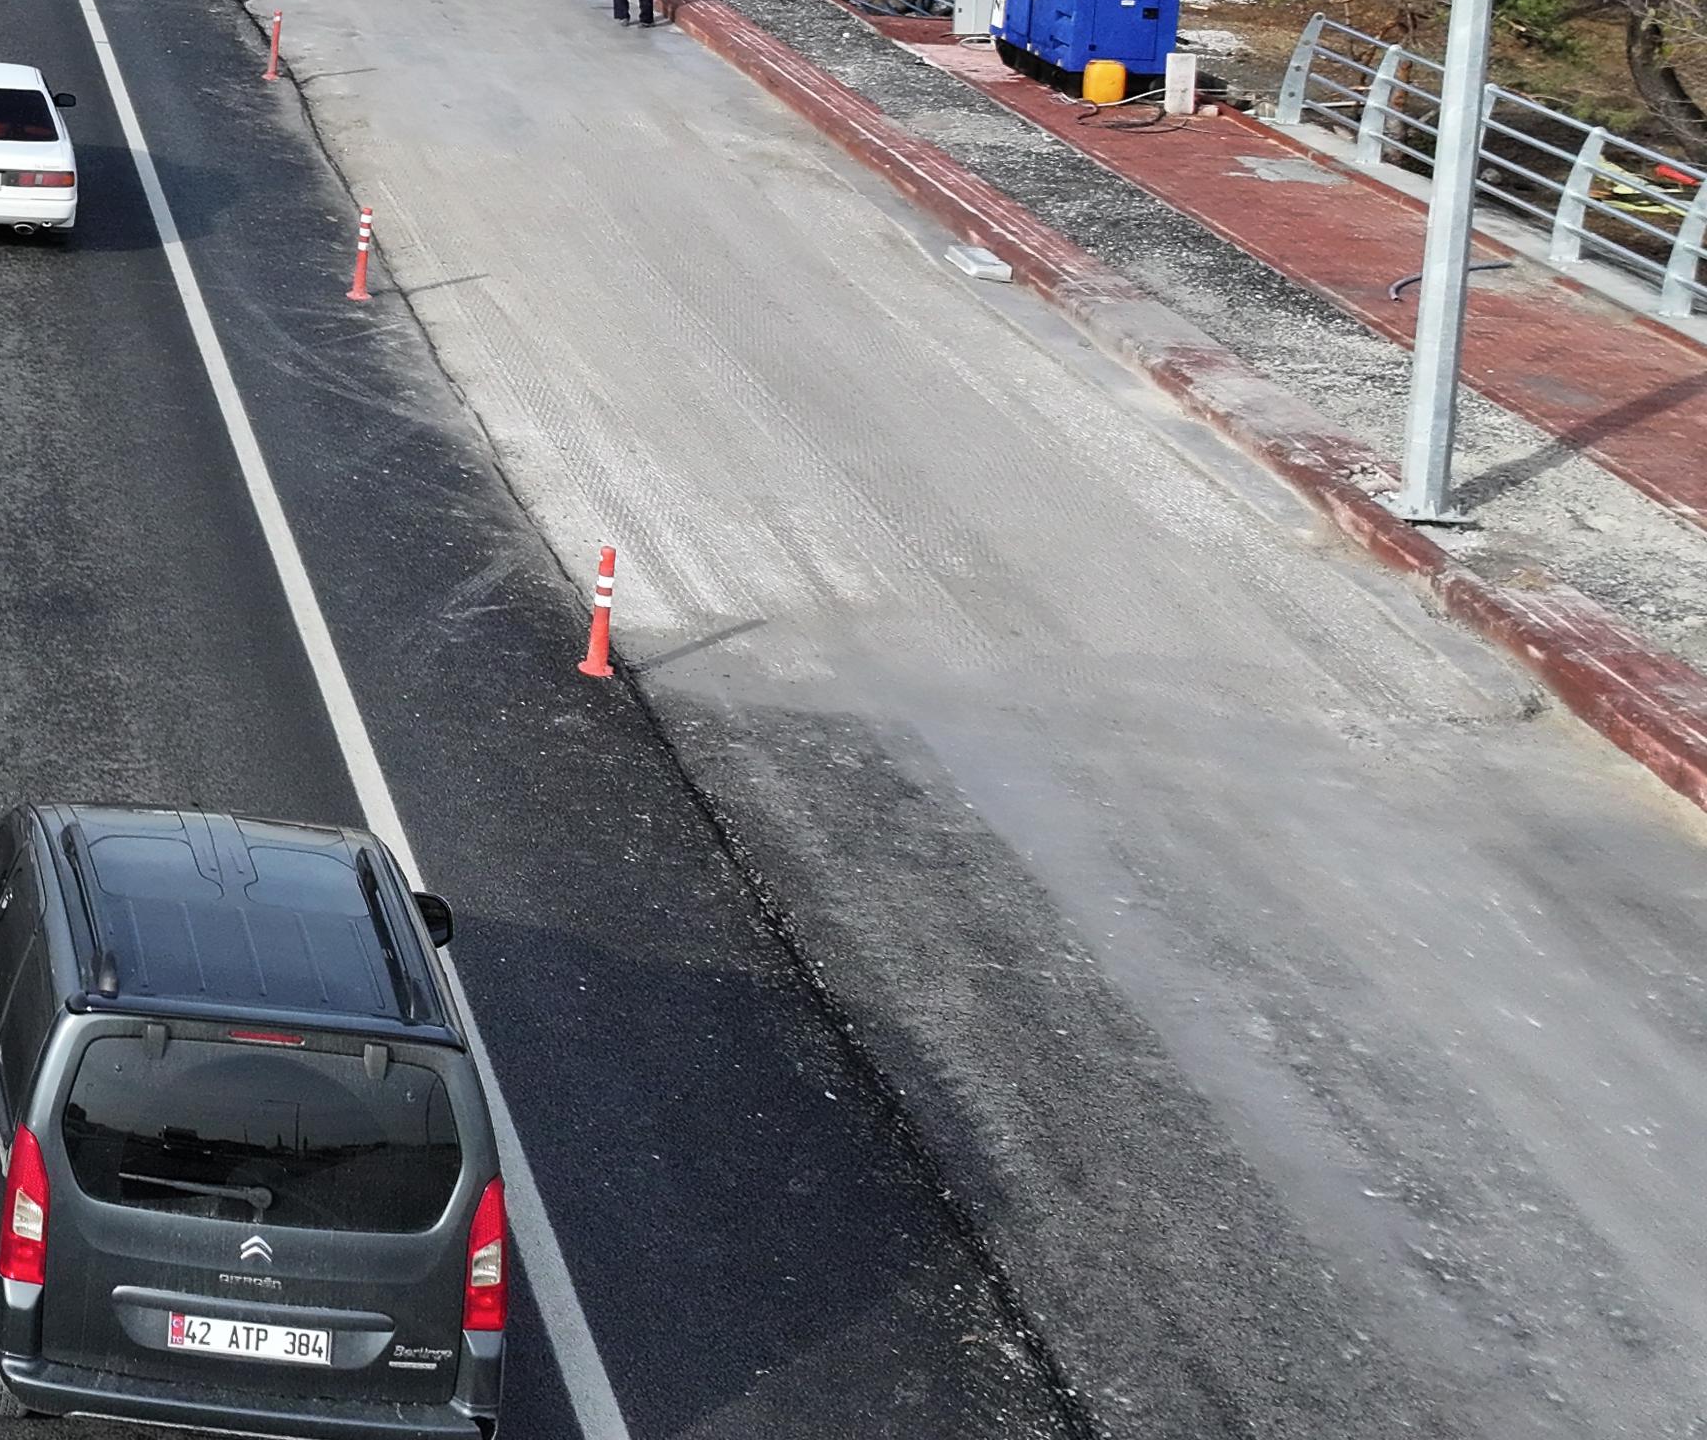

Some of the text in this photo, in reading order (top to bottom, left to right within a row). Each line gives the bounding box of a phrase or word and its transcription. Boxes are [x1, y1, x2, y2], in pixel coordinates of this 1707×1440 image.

[184, 1321, 212, 1346] 42
[227, 1325, 269, 1352] ATP
[283, 1330, 325, 1359] 384
